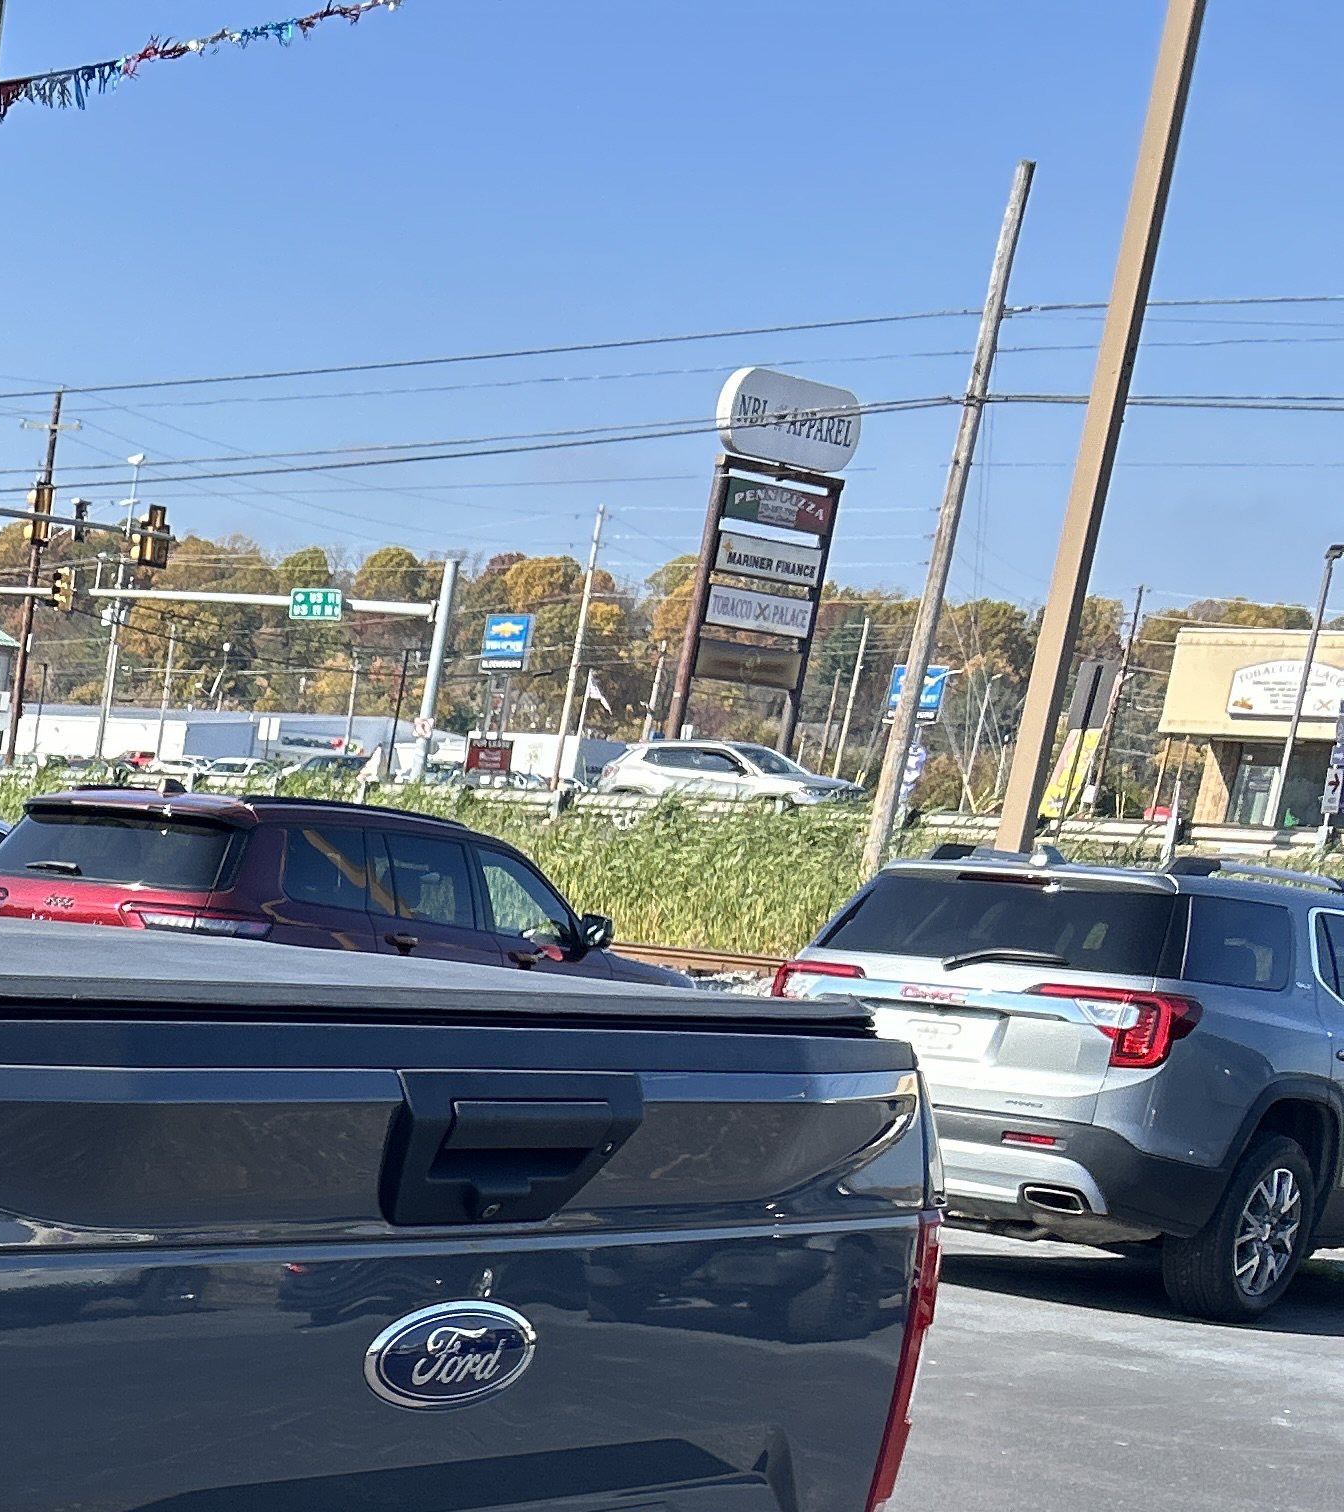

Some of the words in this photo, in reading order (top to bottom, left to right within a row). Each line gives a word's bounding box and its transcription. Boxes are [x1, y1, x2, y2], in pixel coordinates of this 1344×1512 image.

[786, 408, 853, 448] APPAREL
[734, 488, 776, 504] PENN
[780, 491, 824, 521] PIZZA
[727, 551, 773, 572] MARINER
[775, 560, 816, 579] FINANCE
[712, 594, 753, 620] TOBACCO
[772, 605, 809, 629] PALACE
[1237, 663, 1295, 683] TOBACCO
[900, 983, 969, 1004] GMC
[412, 1326, 501, 1386] Ford
